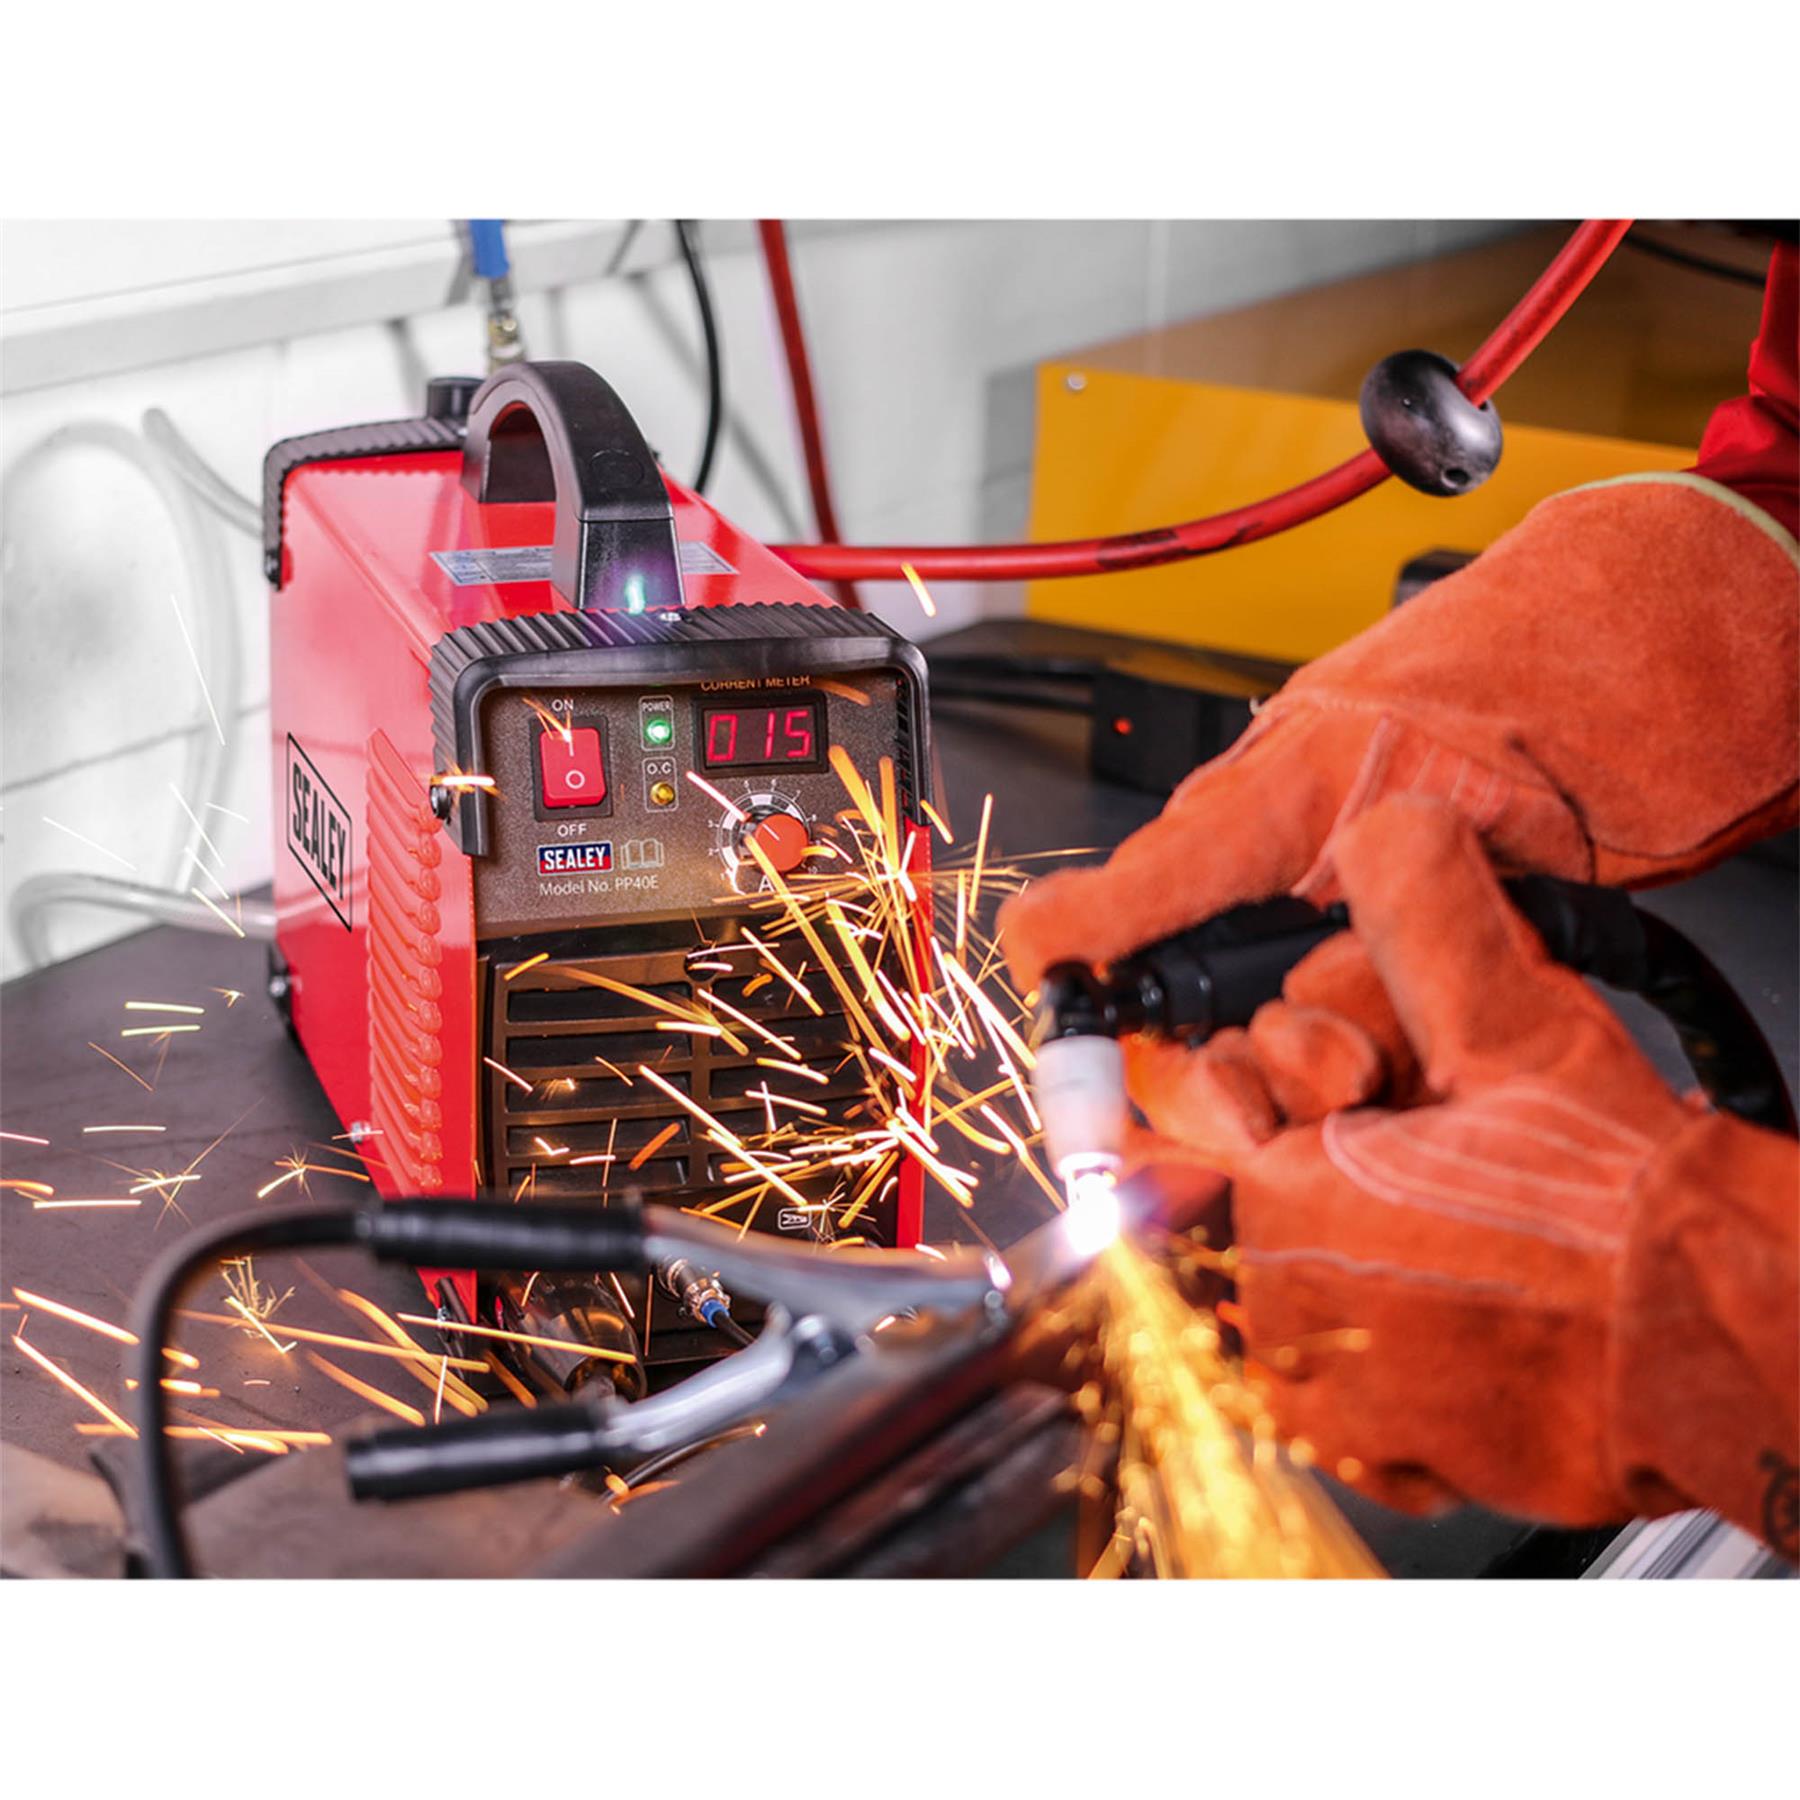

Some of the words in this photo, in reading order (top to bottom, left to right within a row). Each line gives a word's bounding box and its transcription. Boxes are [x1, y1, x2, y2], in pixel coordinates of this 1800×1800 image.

[701, 681, 761, 691] CURRENT
[766, 676, 810, 687] METER
[552, 699, 574, 711] ON
[642, 702, 671, 711] POWER
[708, 710, 811, 760] 015
[293, 762, 346, 900] SEALEY
[557, 824, 587, 836] OFF
[544, 846, 605, 870] SEALEY
[539, 880, 584, 896] Model
[588, 879, 612, 893] No.
[615, 875, 659, 890] PP40E
